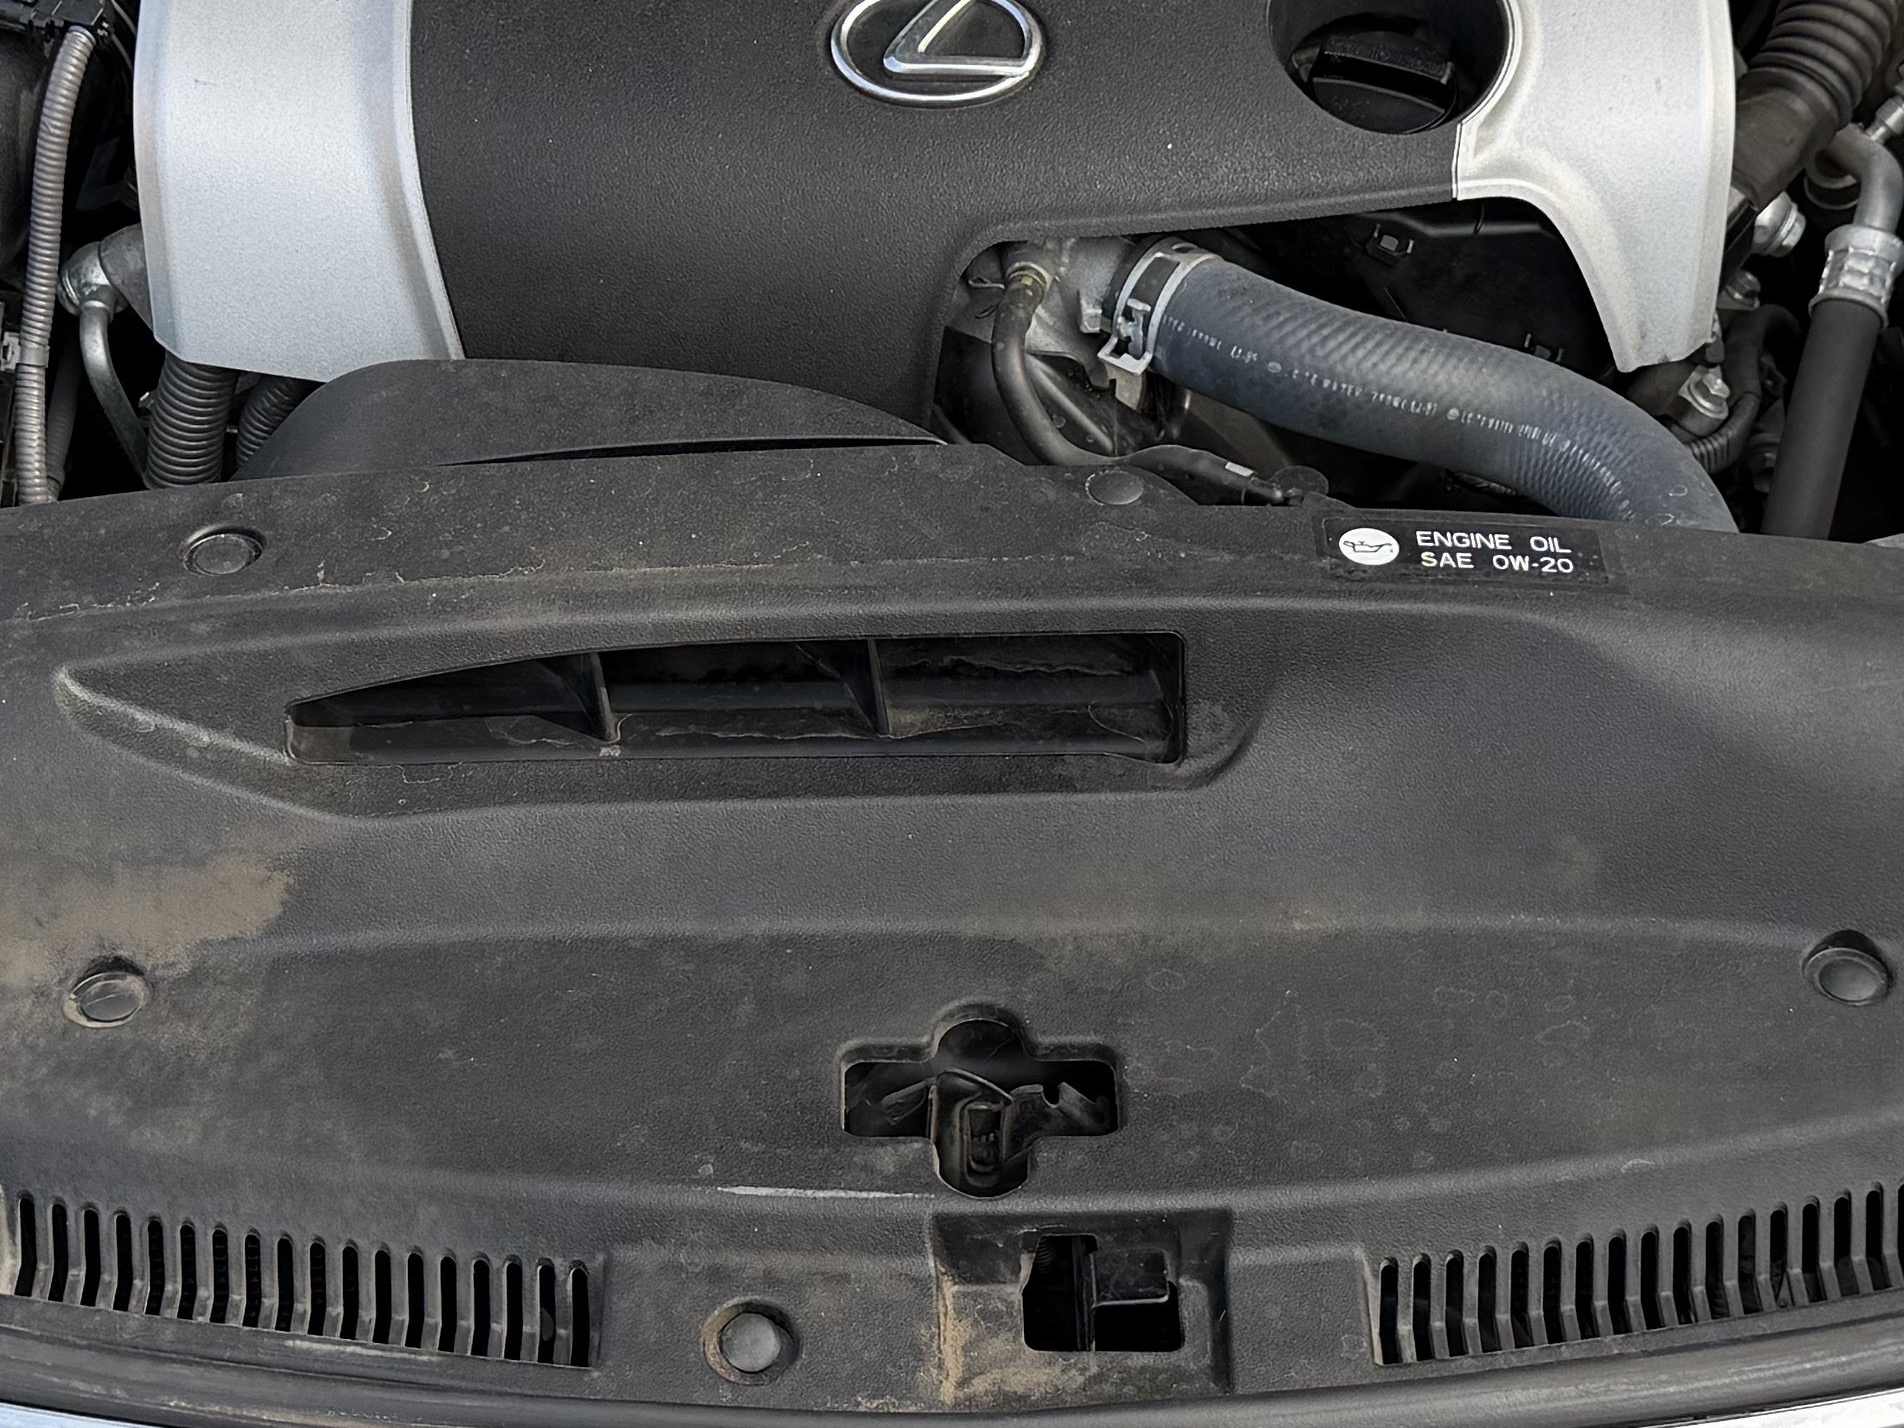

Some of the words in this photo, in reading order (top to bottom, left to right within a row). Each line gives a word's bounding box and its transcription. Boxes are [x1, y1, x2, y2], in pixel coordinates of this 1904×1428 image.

[1415, 530, 1513, 551] ENGINE
[1529, 535, 1573, 554] OIL
[1420, 551, 1475, 569] SAE
[1492, 555, 1575, 574] 0W-20
